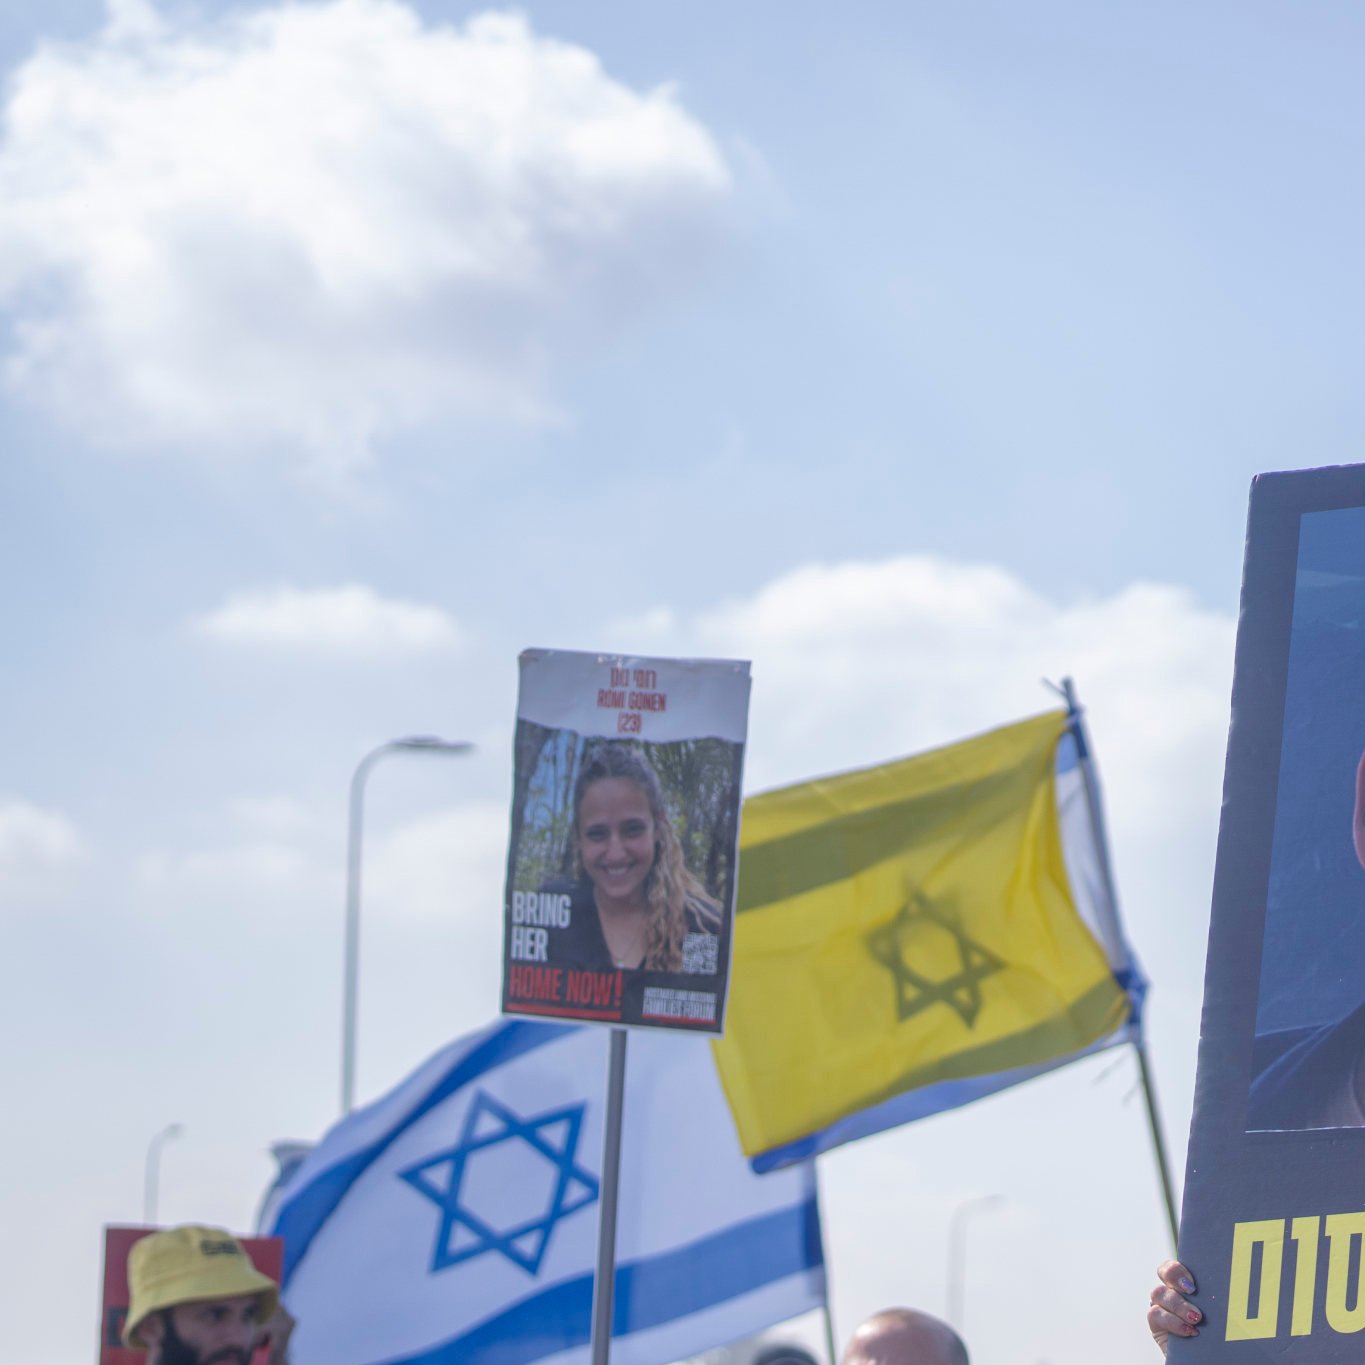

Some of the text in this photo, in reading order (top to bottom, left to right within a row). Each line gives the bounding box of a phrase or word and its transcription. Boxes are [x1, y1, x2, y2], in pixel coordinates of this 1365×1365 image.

[597, 689, 667, 712] ROMI GONEN
[617, 712, 642, 733] (23)
[511, 890, 571, 928] BRING
[510, 927, 548, 961] HER
[508, 965, 623, 1007] HOME NOW!
